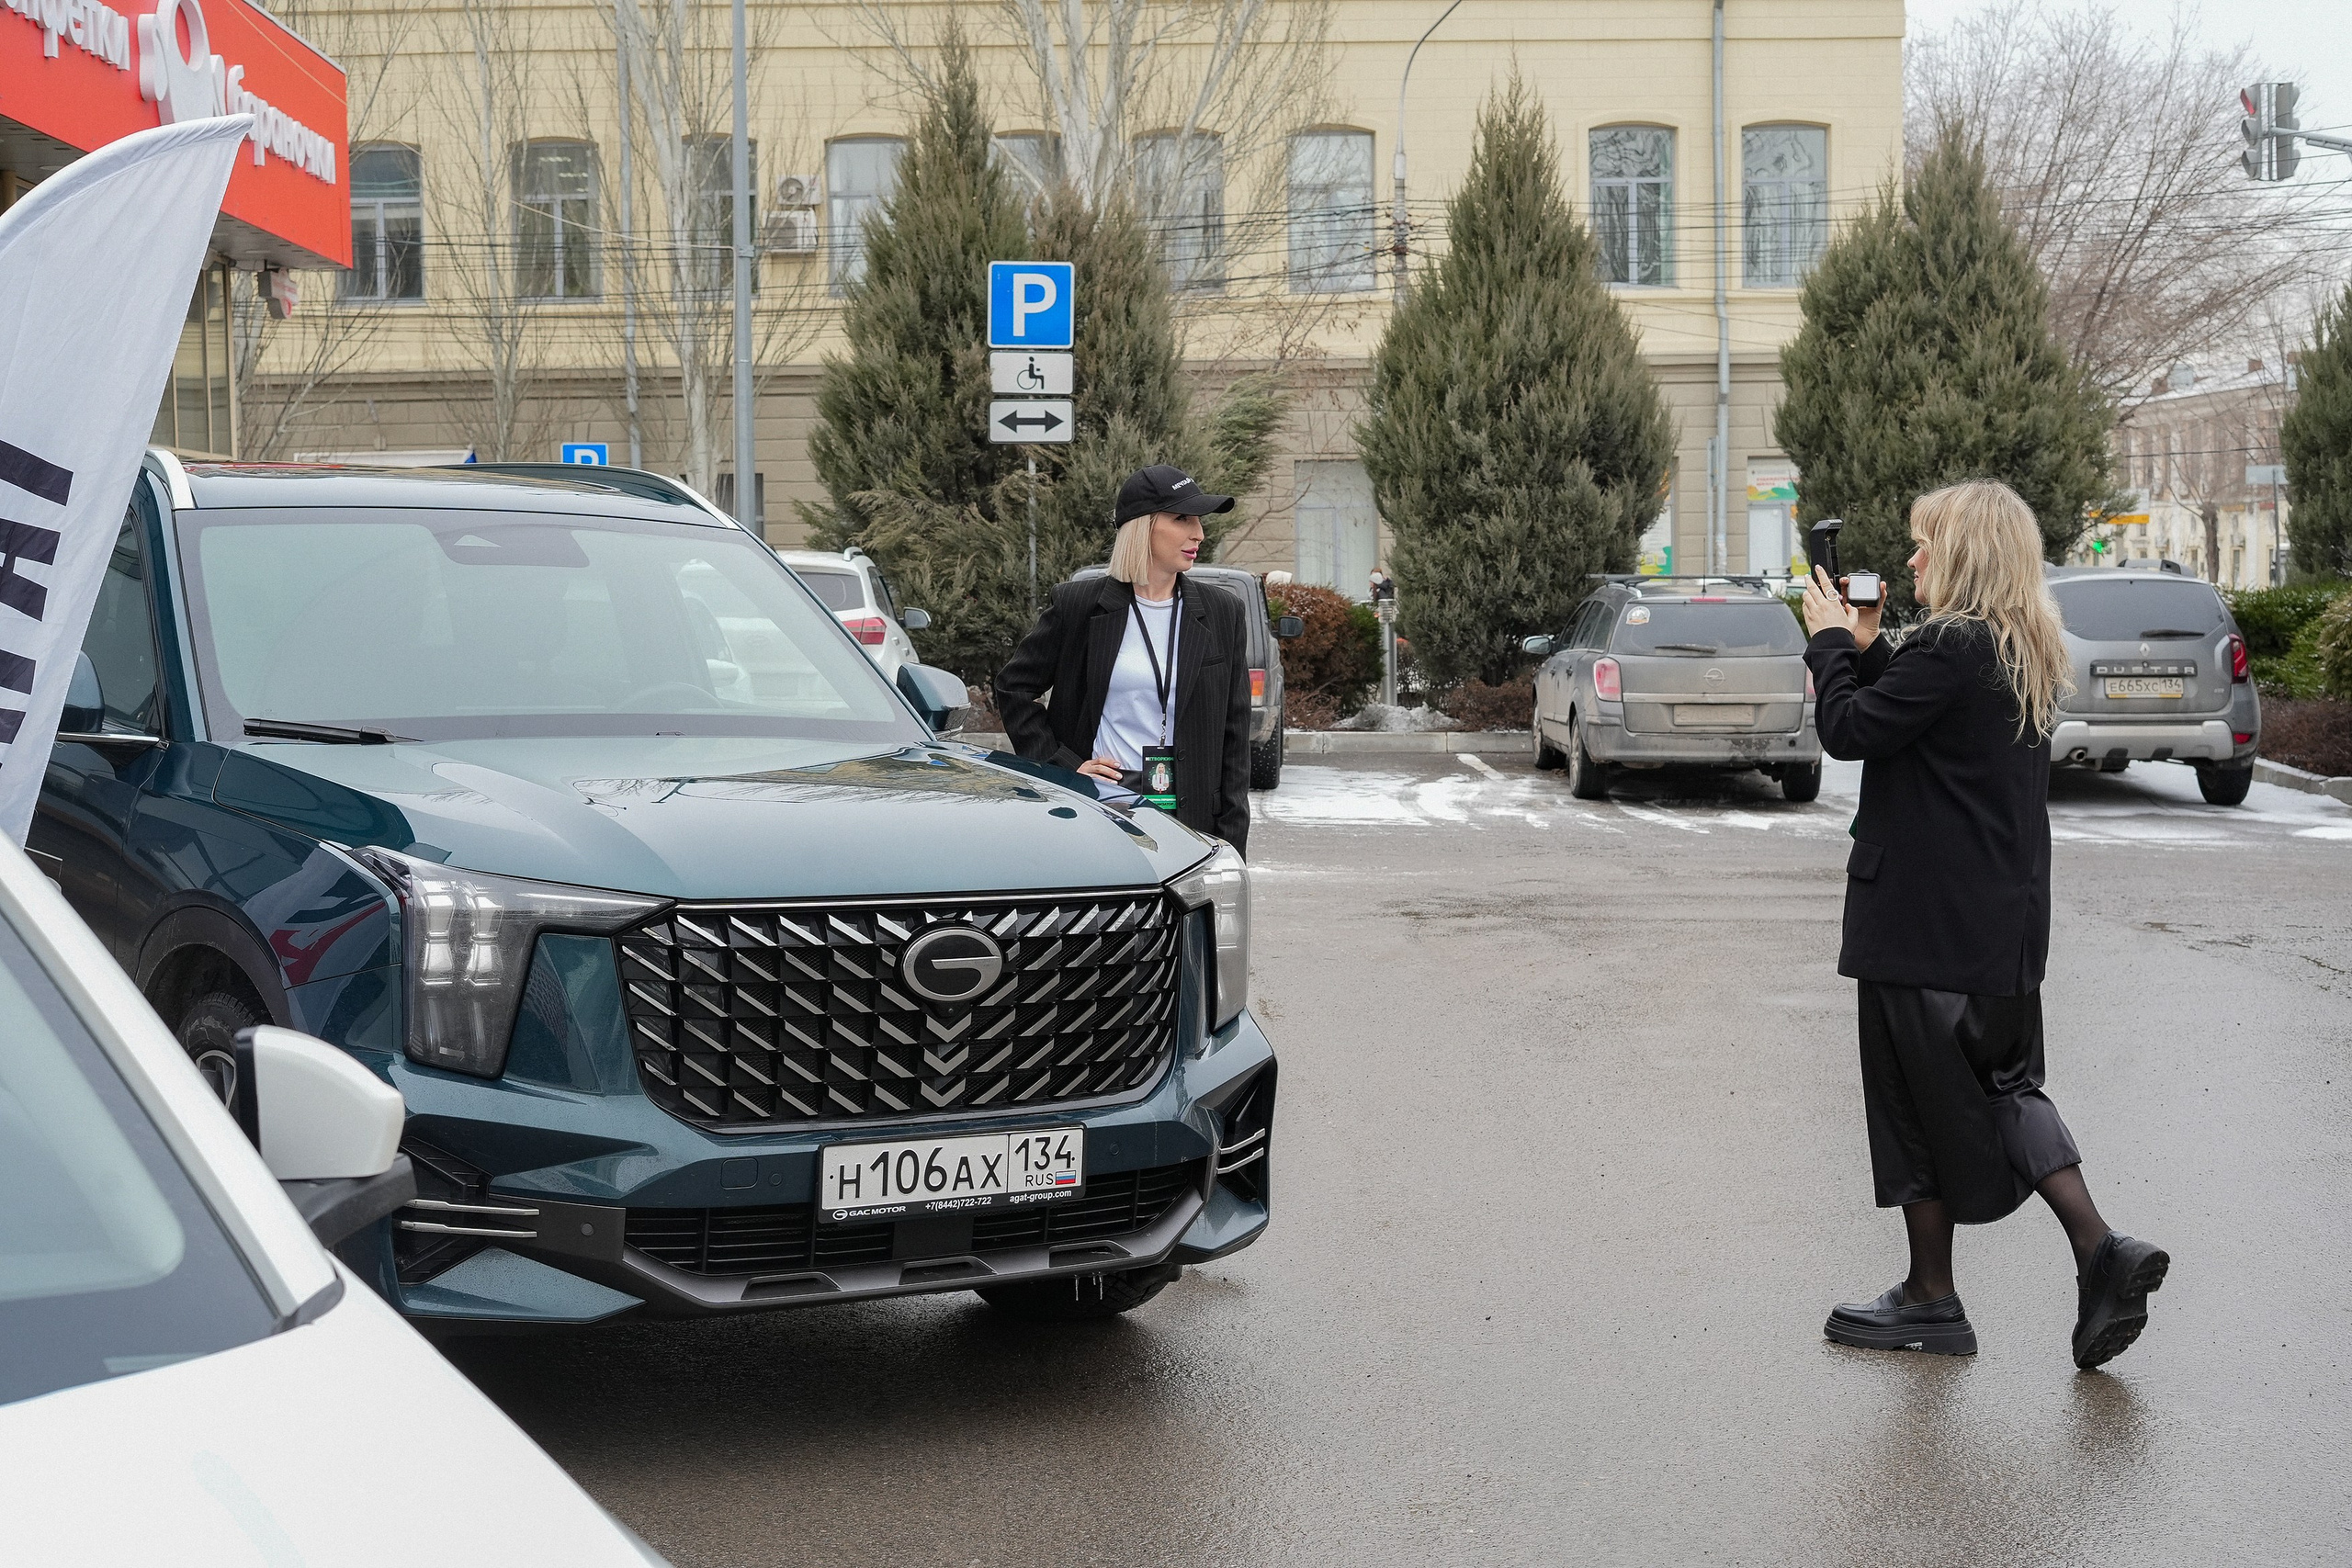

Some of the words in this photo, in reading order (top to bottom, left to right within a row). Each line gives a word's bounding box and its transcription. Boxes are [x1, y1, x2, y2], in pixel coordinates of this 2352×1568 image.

[1013, 273, 1057, 337] P
[2096, 666, 2195, 674] DUSTER
[2109, 679, 2159, 693] Е665ХС
[2162, 679, 2181, 689] 134
[839, 1146, 1002, 1200] Н106АХ
[1014, 1134, 1071, 1171] 134
[1025, 1173, 1054, 1187] RUS
[1010, 1190, 1072, 1203] agat-group.com
[925, 1196, 992, 1212] +7(8442)722-722
